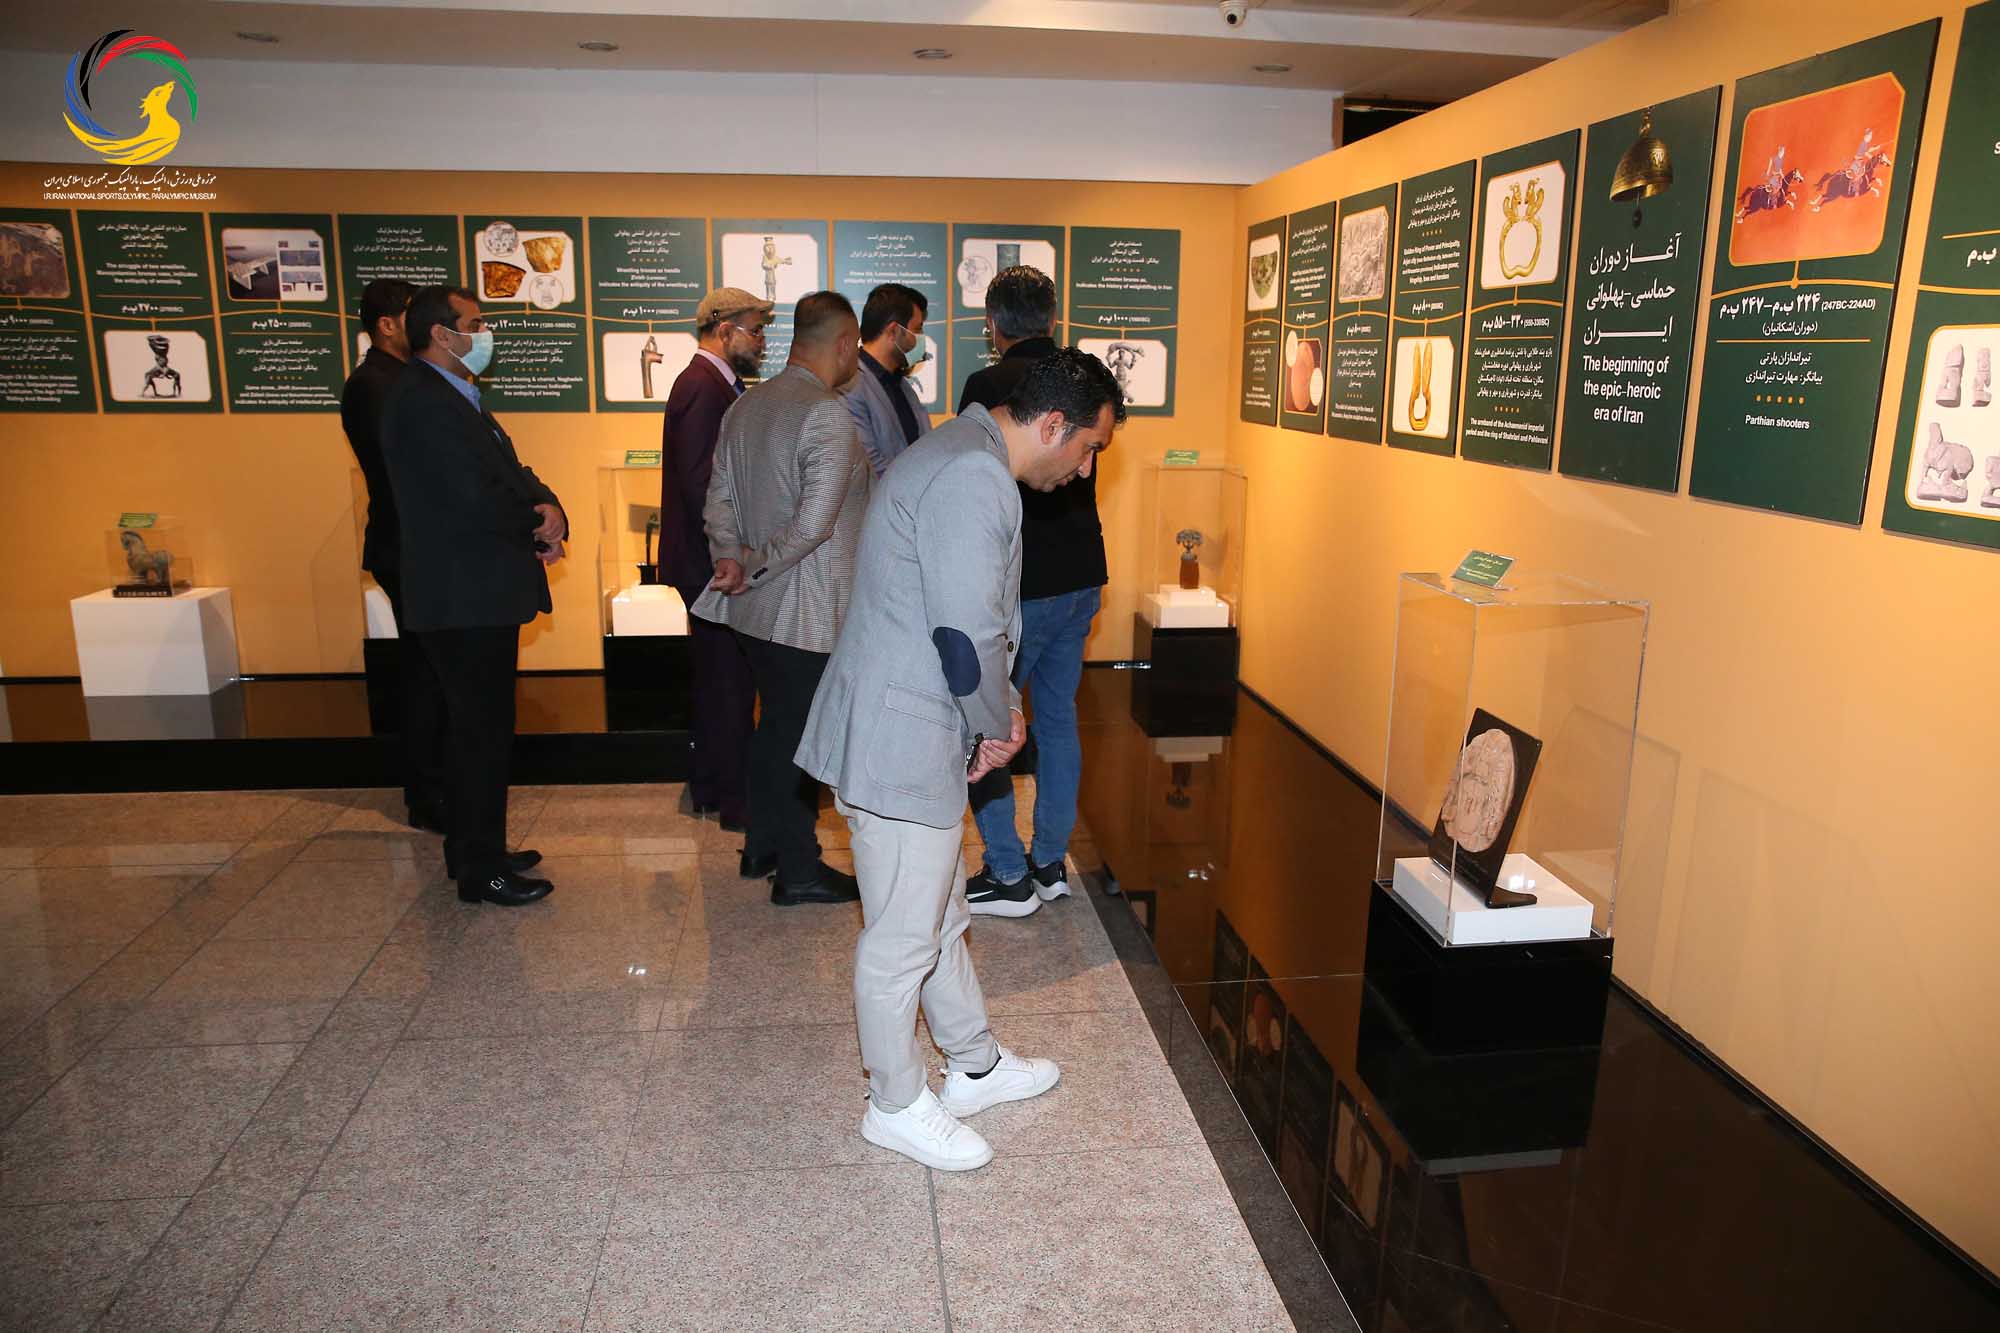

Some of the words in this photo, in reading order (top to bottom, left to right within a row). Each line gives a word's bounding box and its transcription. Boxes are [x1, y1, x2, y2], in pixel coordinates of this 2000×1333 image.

[1622, 232, 1682, 271] آغاز
[1590, 247, 1621, 275] دوران
[1583, 315, 1673, 345] ایران
[1583, 355, 1600, 371] The
[1602, 355, 1655, 377] beginning
[1656, 356, 1670, 373] of
[1760, 353, 1778, 366] پارتی
[1778, 351, 1812, 365] تیراندازان
[1745, 370, 1776, 384] تیراندازی
[1776, 371, 1798, 383] مهارت
[1800, 371, 1823, 385] بیانگر:
[1583, 379, 1599, 395] the
[1600, 380, 1661, 400] epic-heroic
[1593, 407, 1610, 421] era
[1611, 405, 1623, 422] of
[1623, 406, 1644, 424] Iran
[1745, 415, 1775, 426] Parthian
[1775, 419, 1810, 430] shooters
